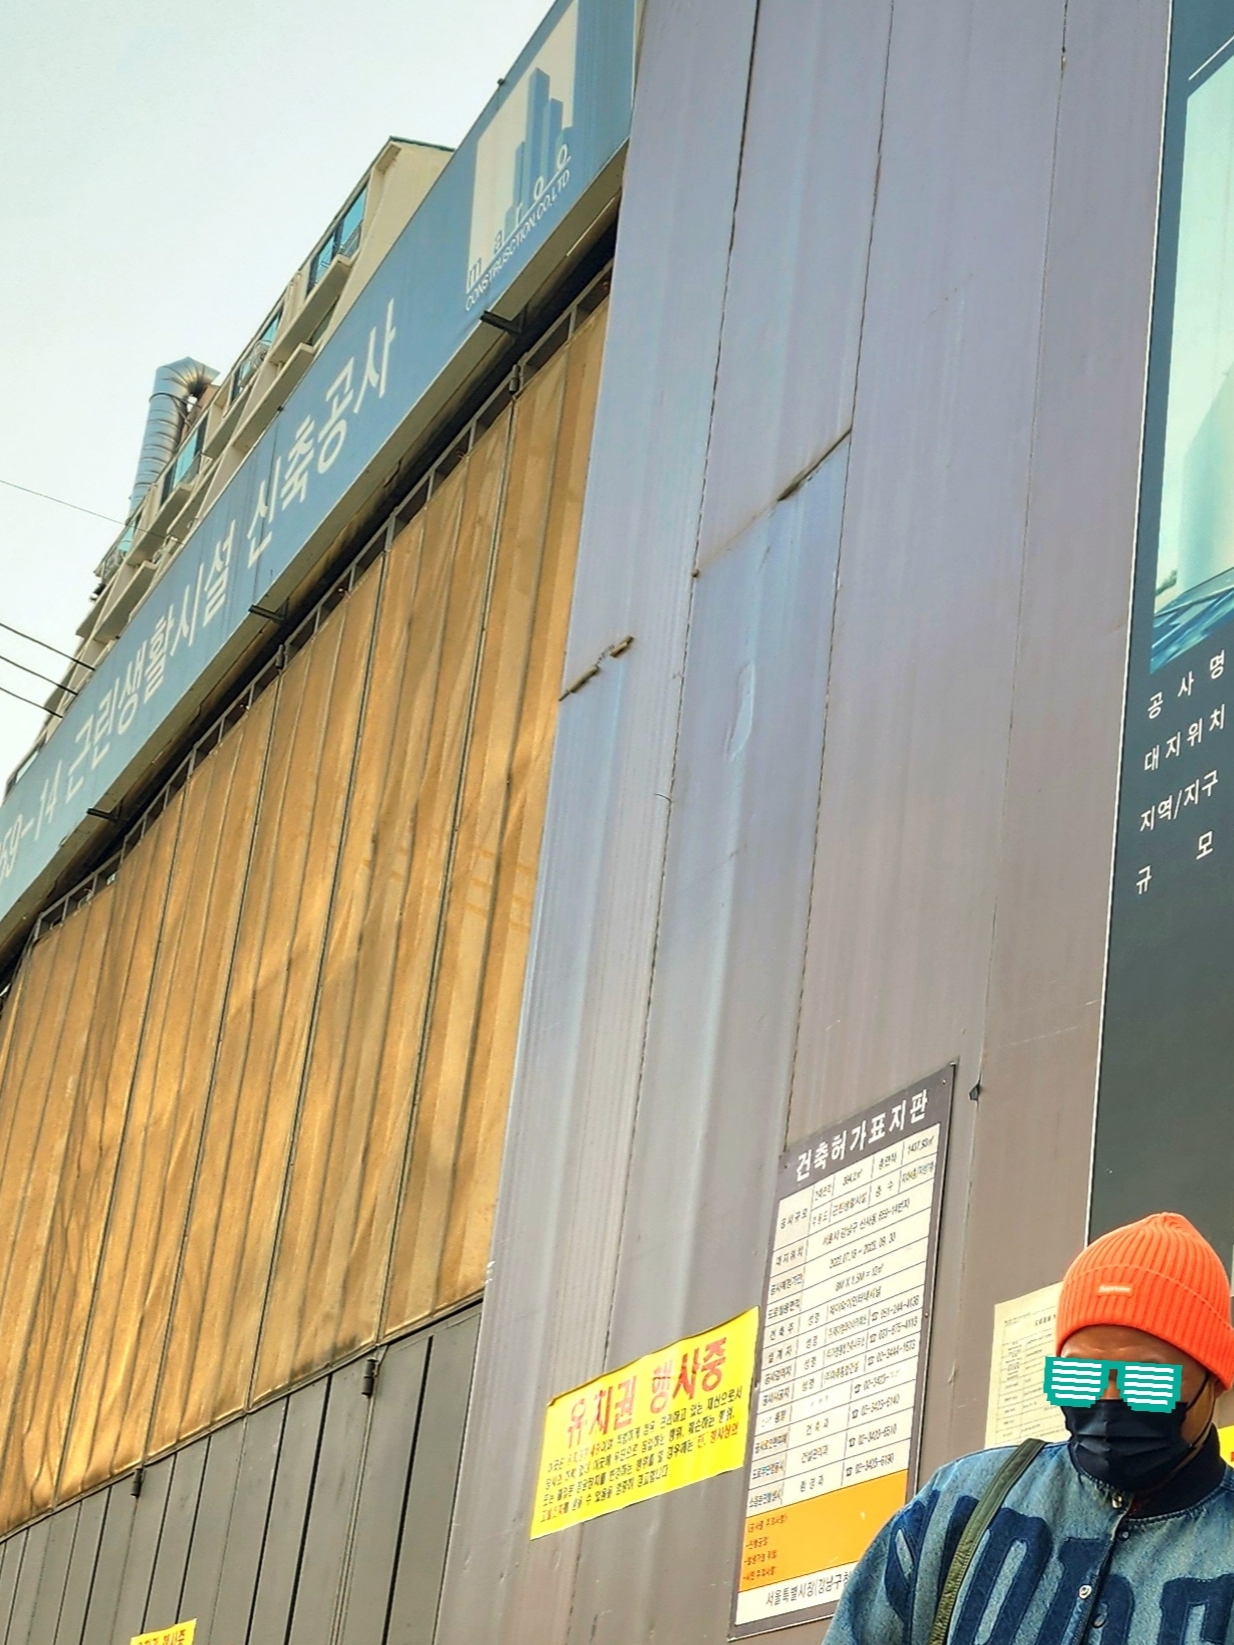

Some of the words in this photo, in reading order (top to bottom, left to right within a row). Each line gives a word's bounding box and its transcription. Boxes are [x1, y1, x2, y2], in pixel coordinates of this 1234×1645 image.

[63, 524, 232, 803] 근린생활시설
[246, 299, 398, 568] 신축공사
[1140, 770, 1219, 832] 지역/지구
[796, 1089, 929, 1182] 건축허가표지판
[567, 1376, 638, 1449] 유치권
[650, 1337, 727, 1414] 행사중
